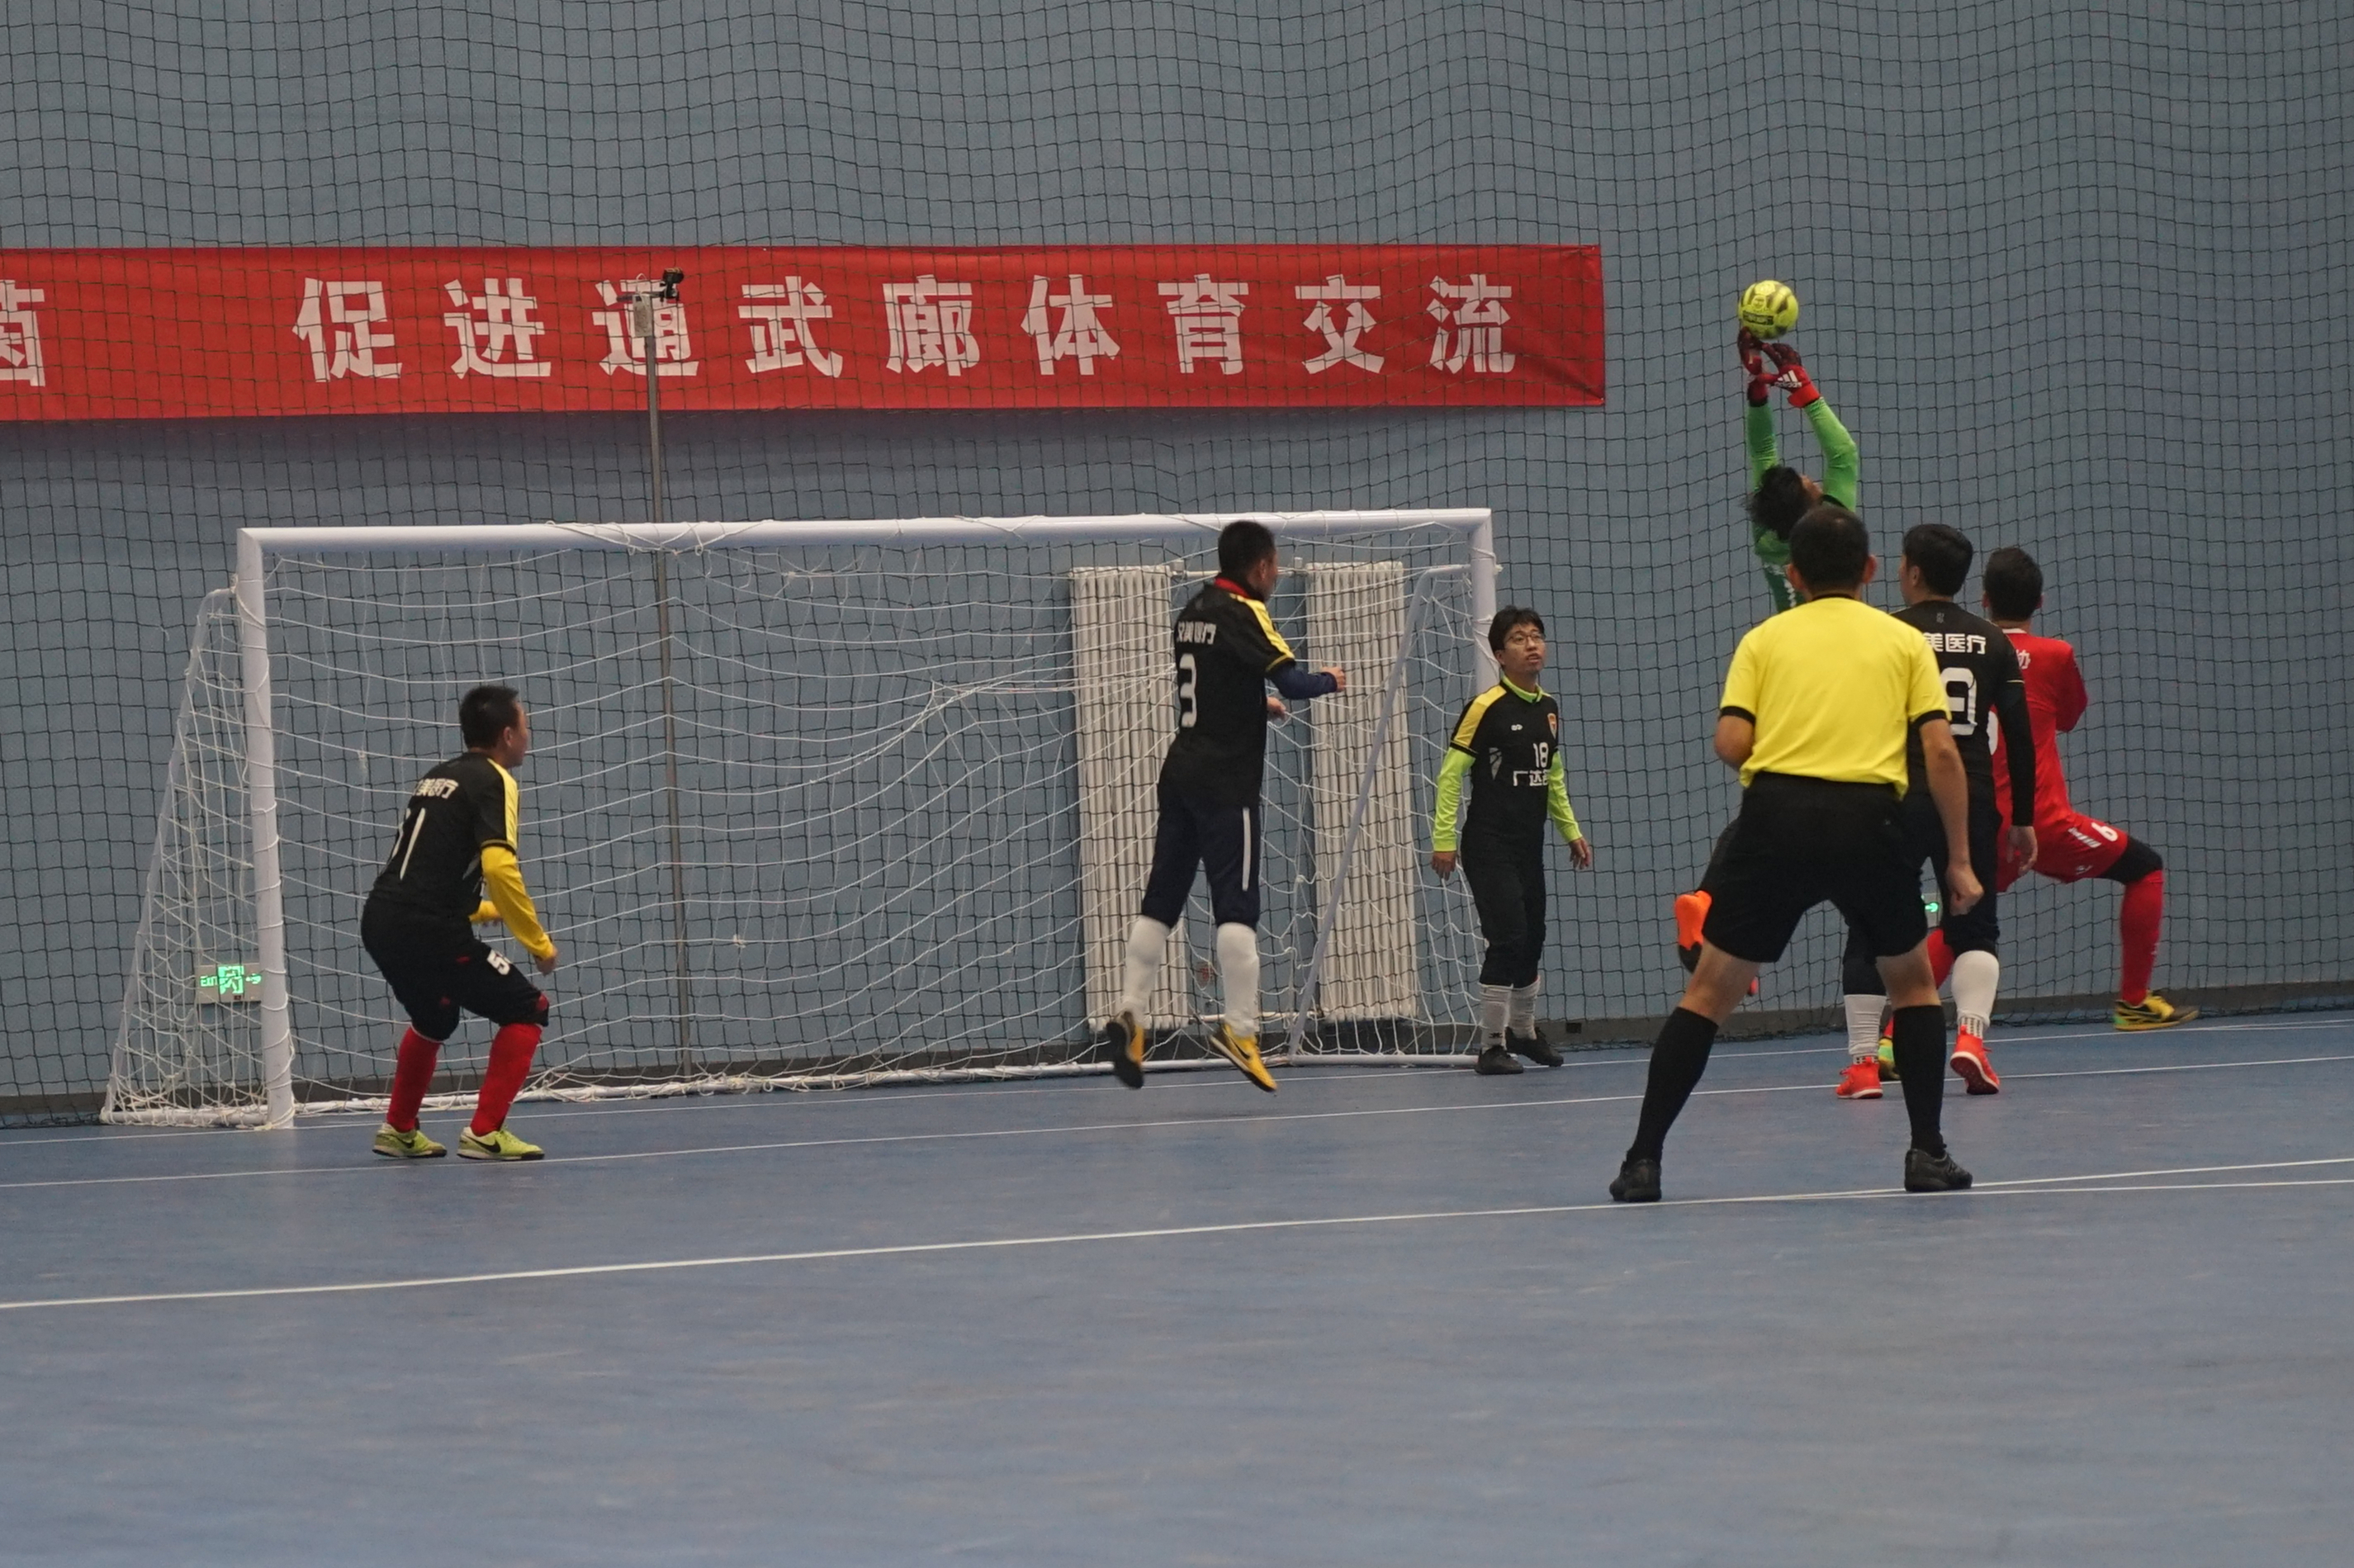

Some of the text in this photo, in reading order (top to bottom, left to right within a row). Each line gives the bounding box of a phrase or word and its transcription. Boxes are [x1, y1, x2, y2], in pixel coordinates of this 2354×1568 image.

[292, 273, 1516, 383] 促进通武廊体育交流
[1179, 653, 1196, 727] 3
[1532, 741, 1549, 769] 18
